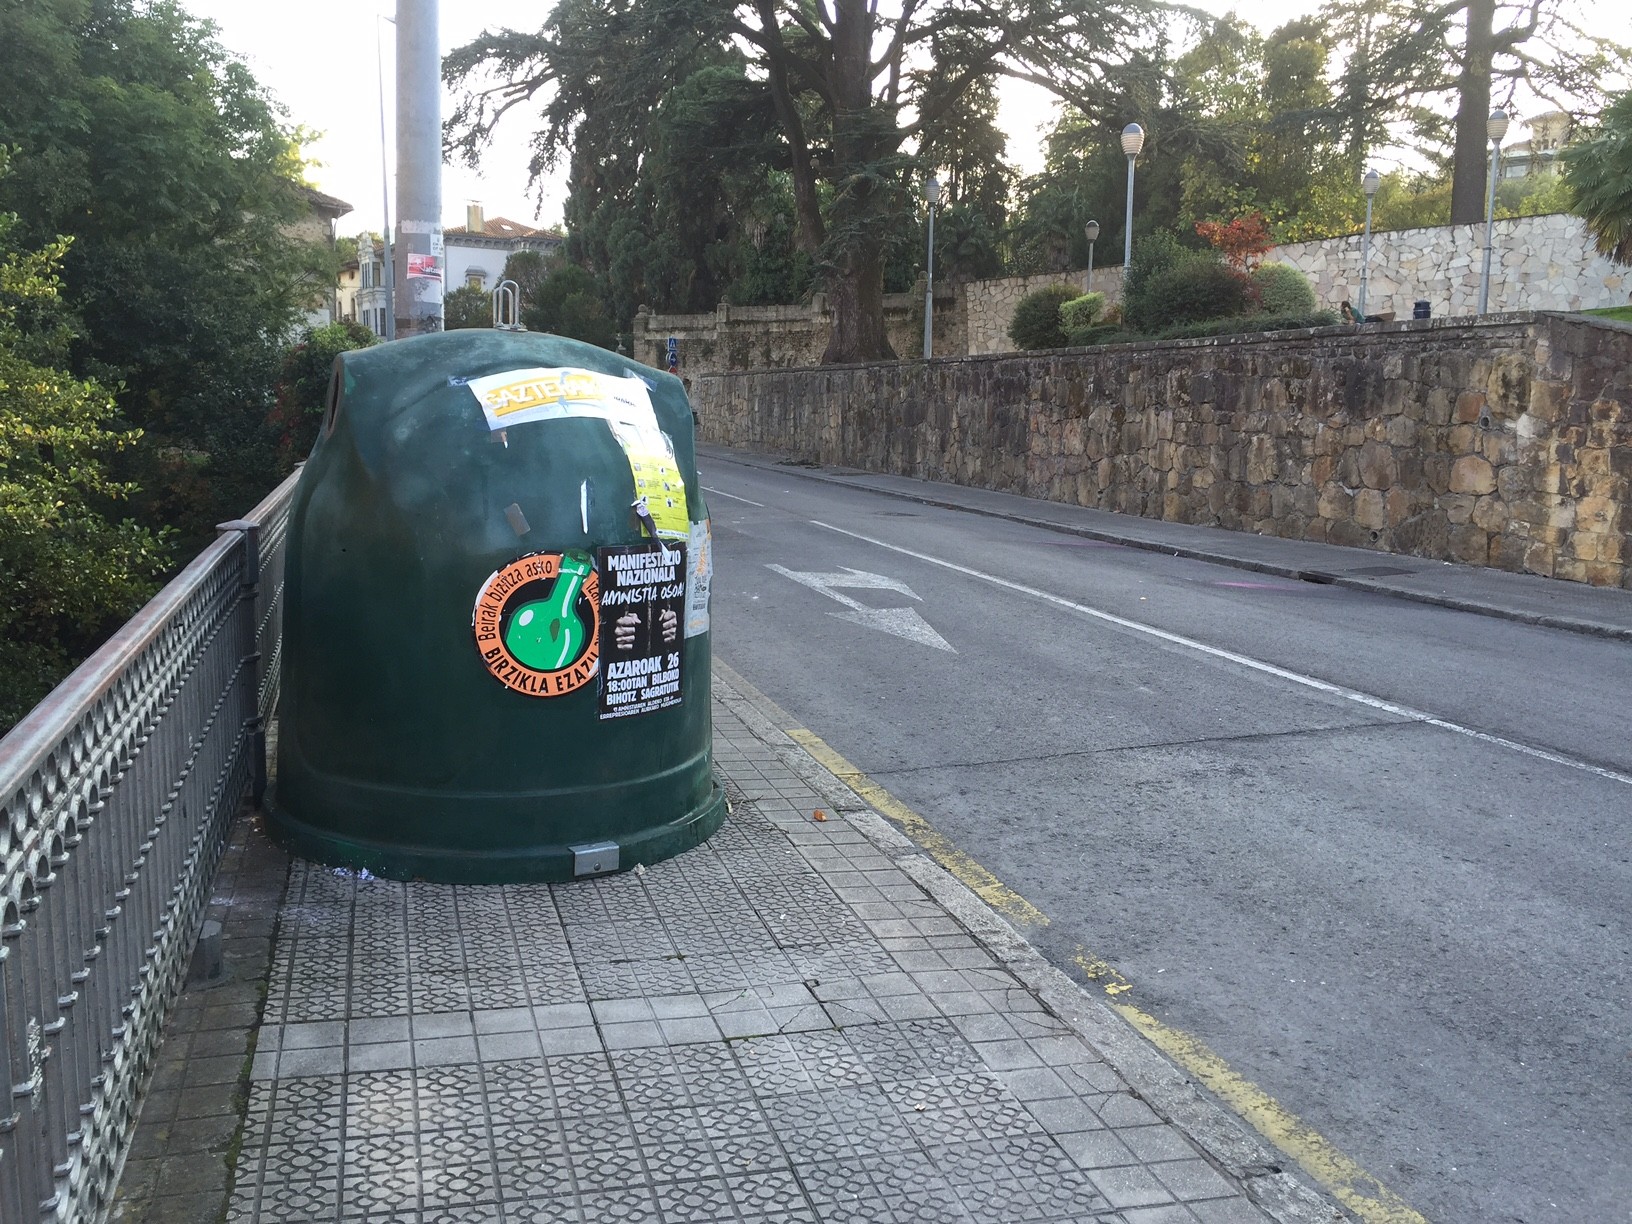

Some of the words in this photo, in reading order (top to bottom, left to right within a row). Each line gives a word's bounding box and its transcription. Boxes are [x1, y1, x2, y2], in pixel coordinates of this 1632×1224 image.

[526, 560, 553, 578] asko
[616, 566, 676, 587] NAZIONALA
[485, 569, 524, 601] bizitza
[601, 586, 658, 606] AMNISTIA
[477, 602, 498, 641] Beirak
[485, 647, 549, 693] BIRZIKLA
[607, 655, 662, 680] AZAROAK
[667, 652, 679, 669] 26
[606, 674, 648, 692] 18:00TAN
[652, 668, 680, 684] BILBOKO
[606, 690, 637, 705] BIHOTZ
[640, 681, 680, 700] SAGRATUTIK
